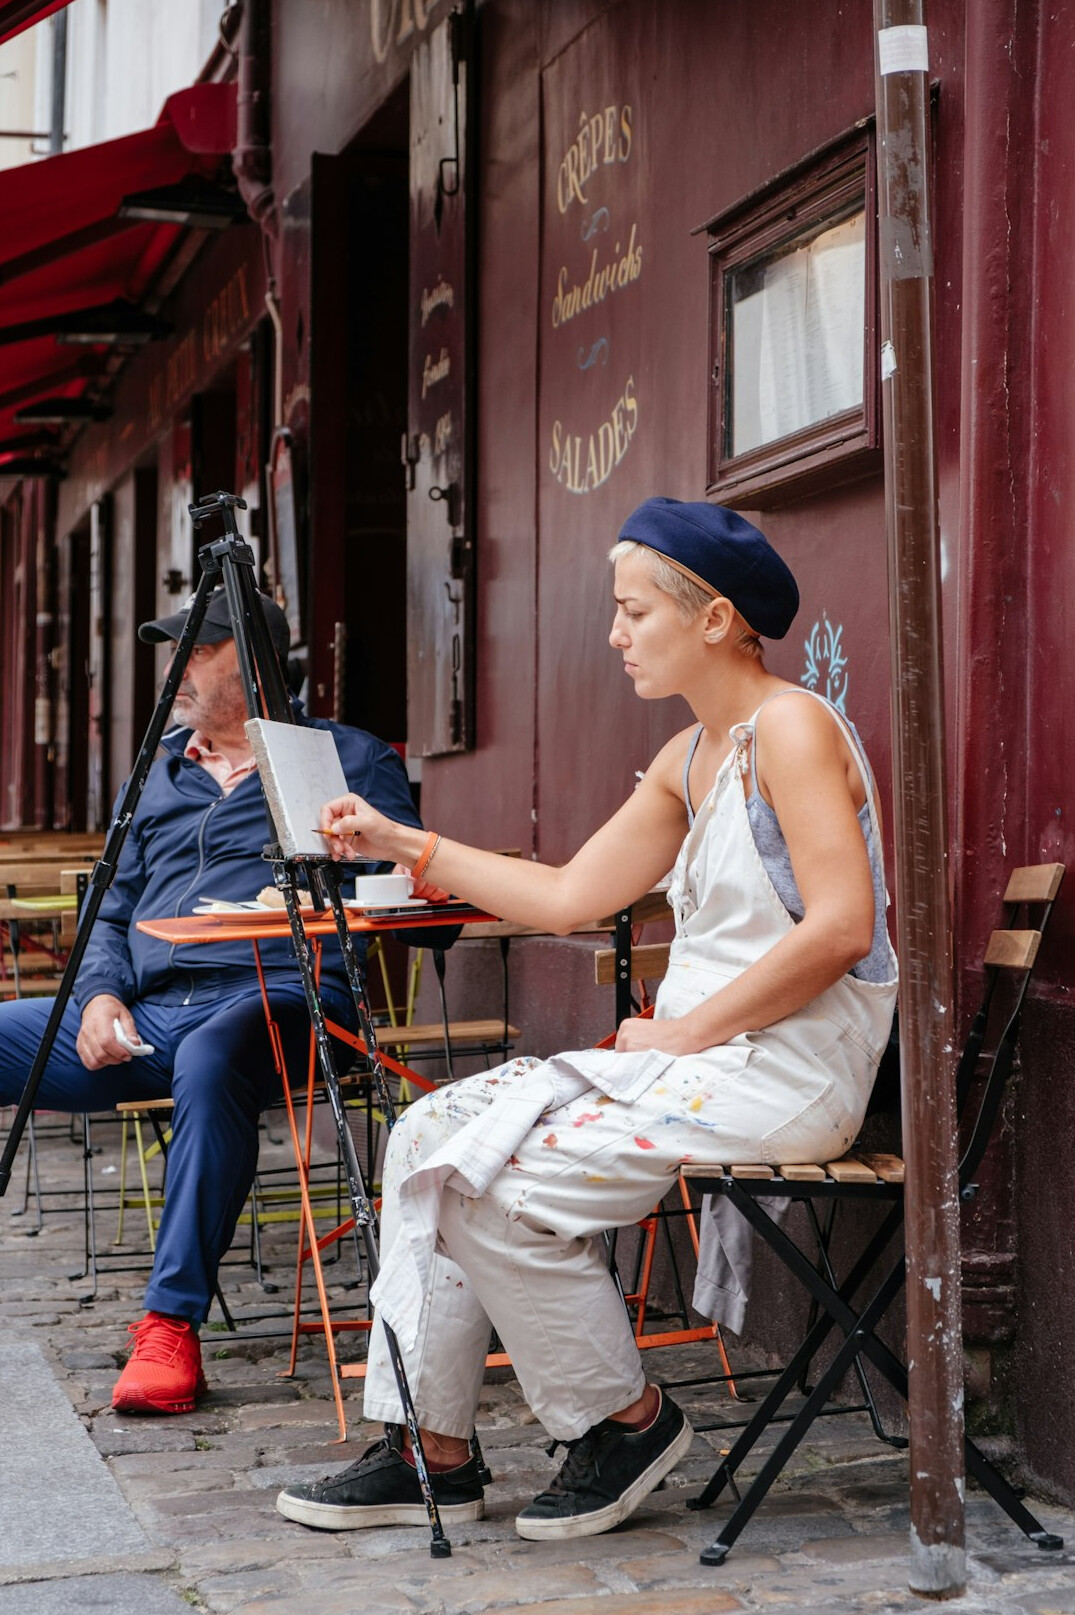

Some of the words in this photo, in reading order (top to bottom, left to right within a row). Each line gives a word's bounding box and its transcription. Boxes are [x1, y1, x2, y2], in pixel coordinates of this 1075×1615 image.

[558, 104, 632, 214] CRÊPES
[552, 223, 643, 328] Sandwichs
[549, 375, 638, 495] SALADES
